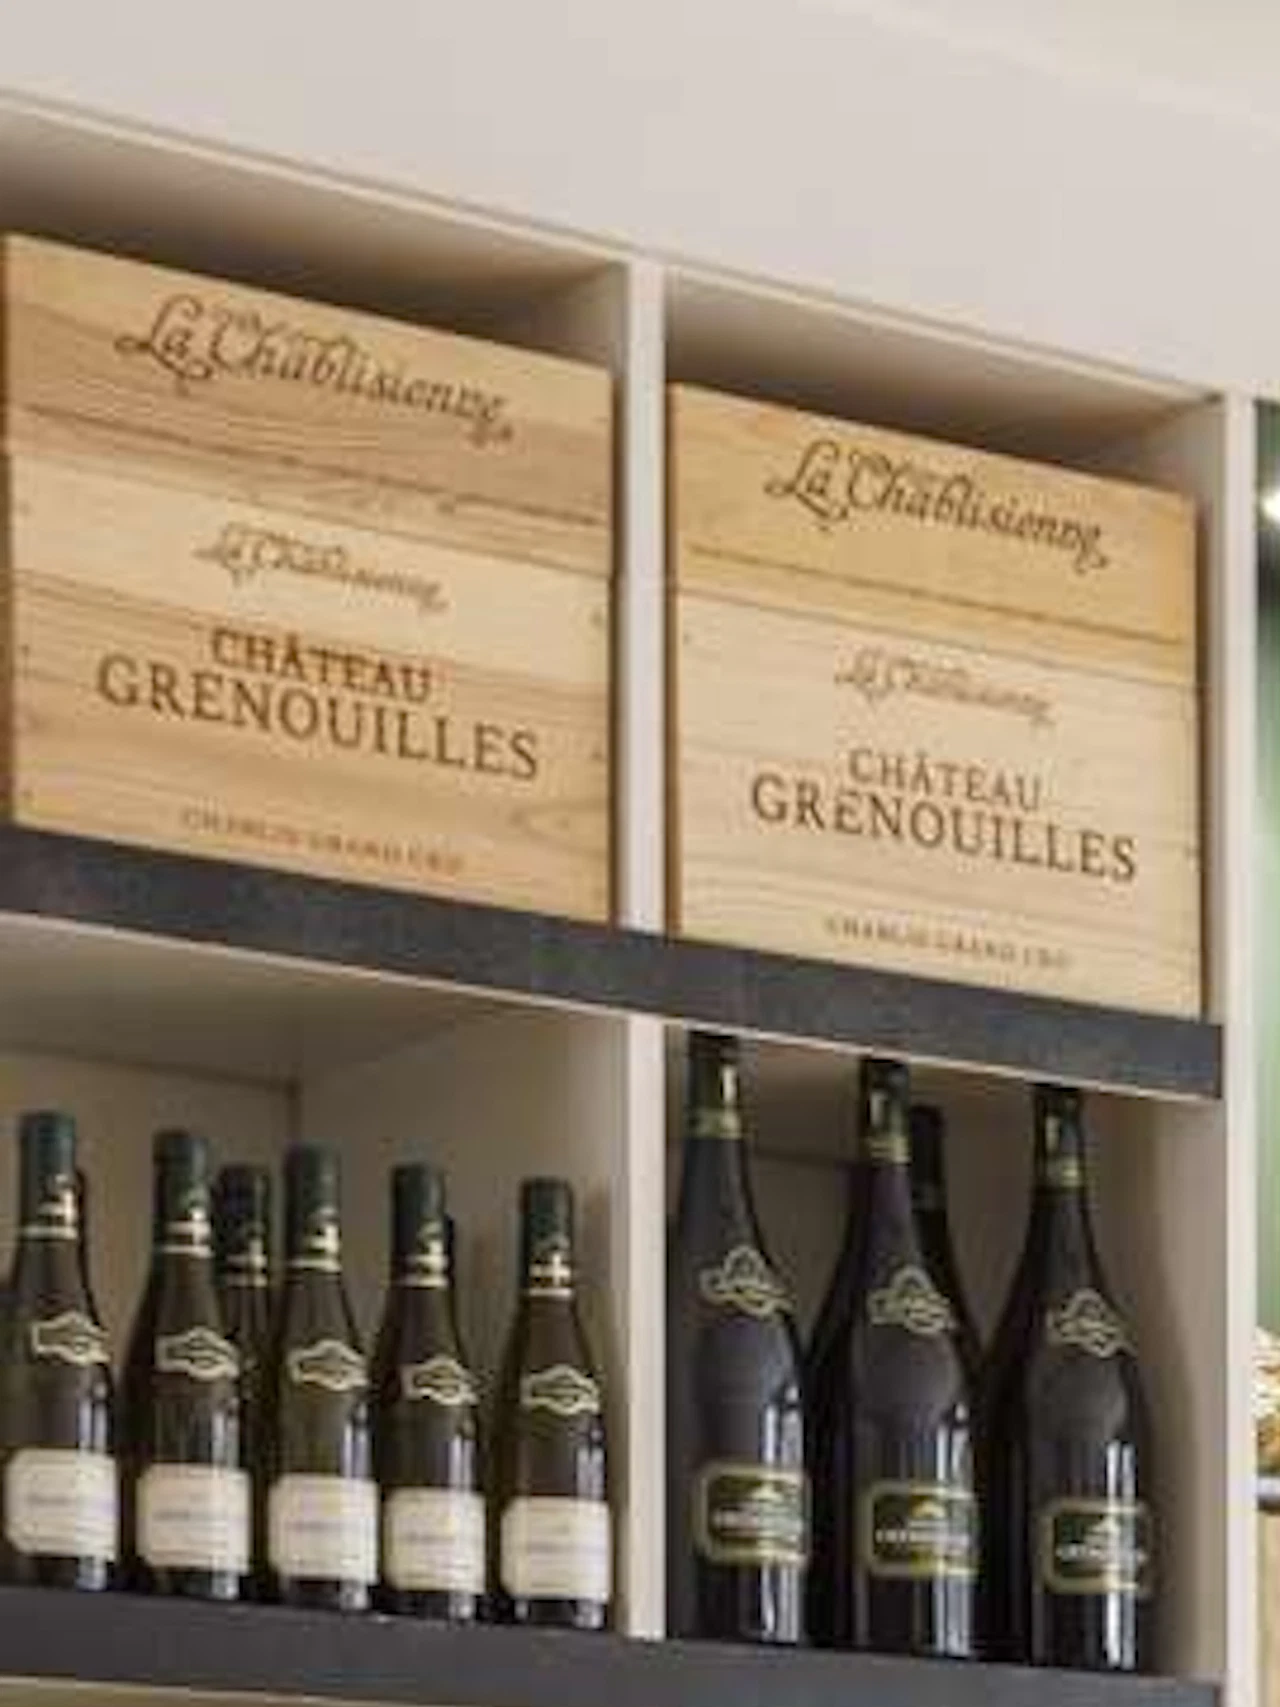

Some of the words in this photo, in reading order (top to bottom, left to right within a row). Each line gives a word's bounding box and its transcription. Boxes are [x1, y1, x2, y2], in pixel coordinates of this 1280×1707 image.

[114, 294, 214, 396] La
[763, 440, 848, 533] La
[209, 624, 434, 703] CHÂTEAU
[97, 653, 540, 782] GRENOUILLES
[751, 772, 1138, 884] GRENOUILLES
[848, 746, 1043, 813] CHÂTEAU
